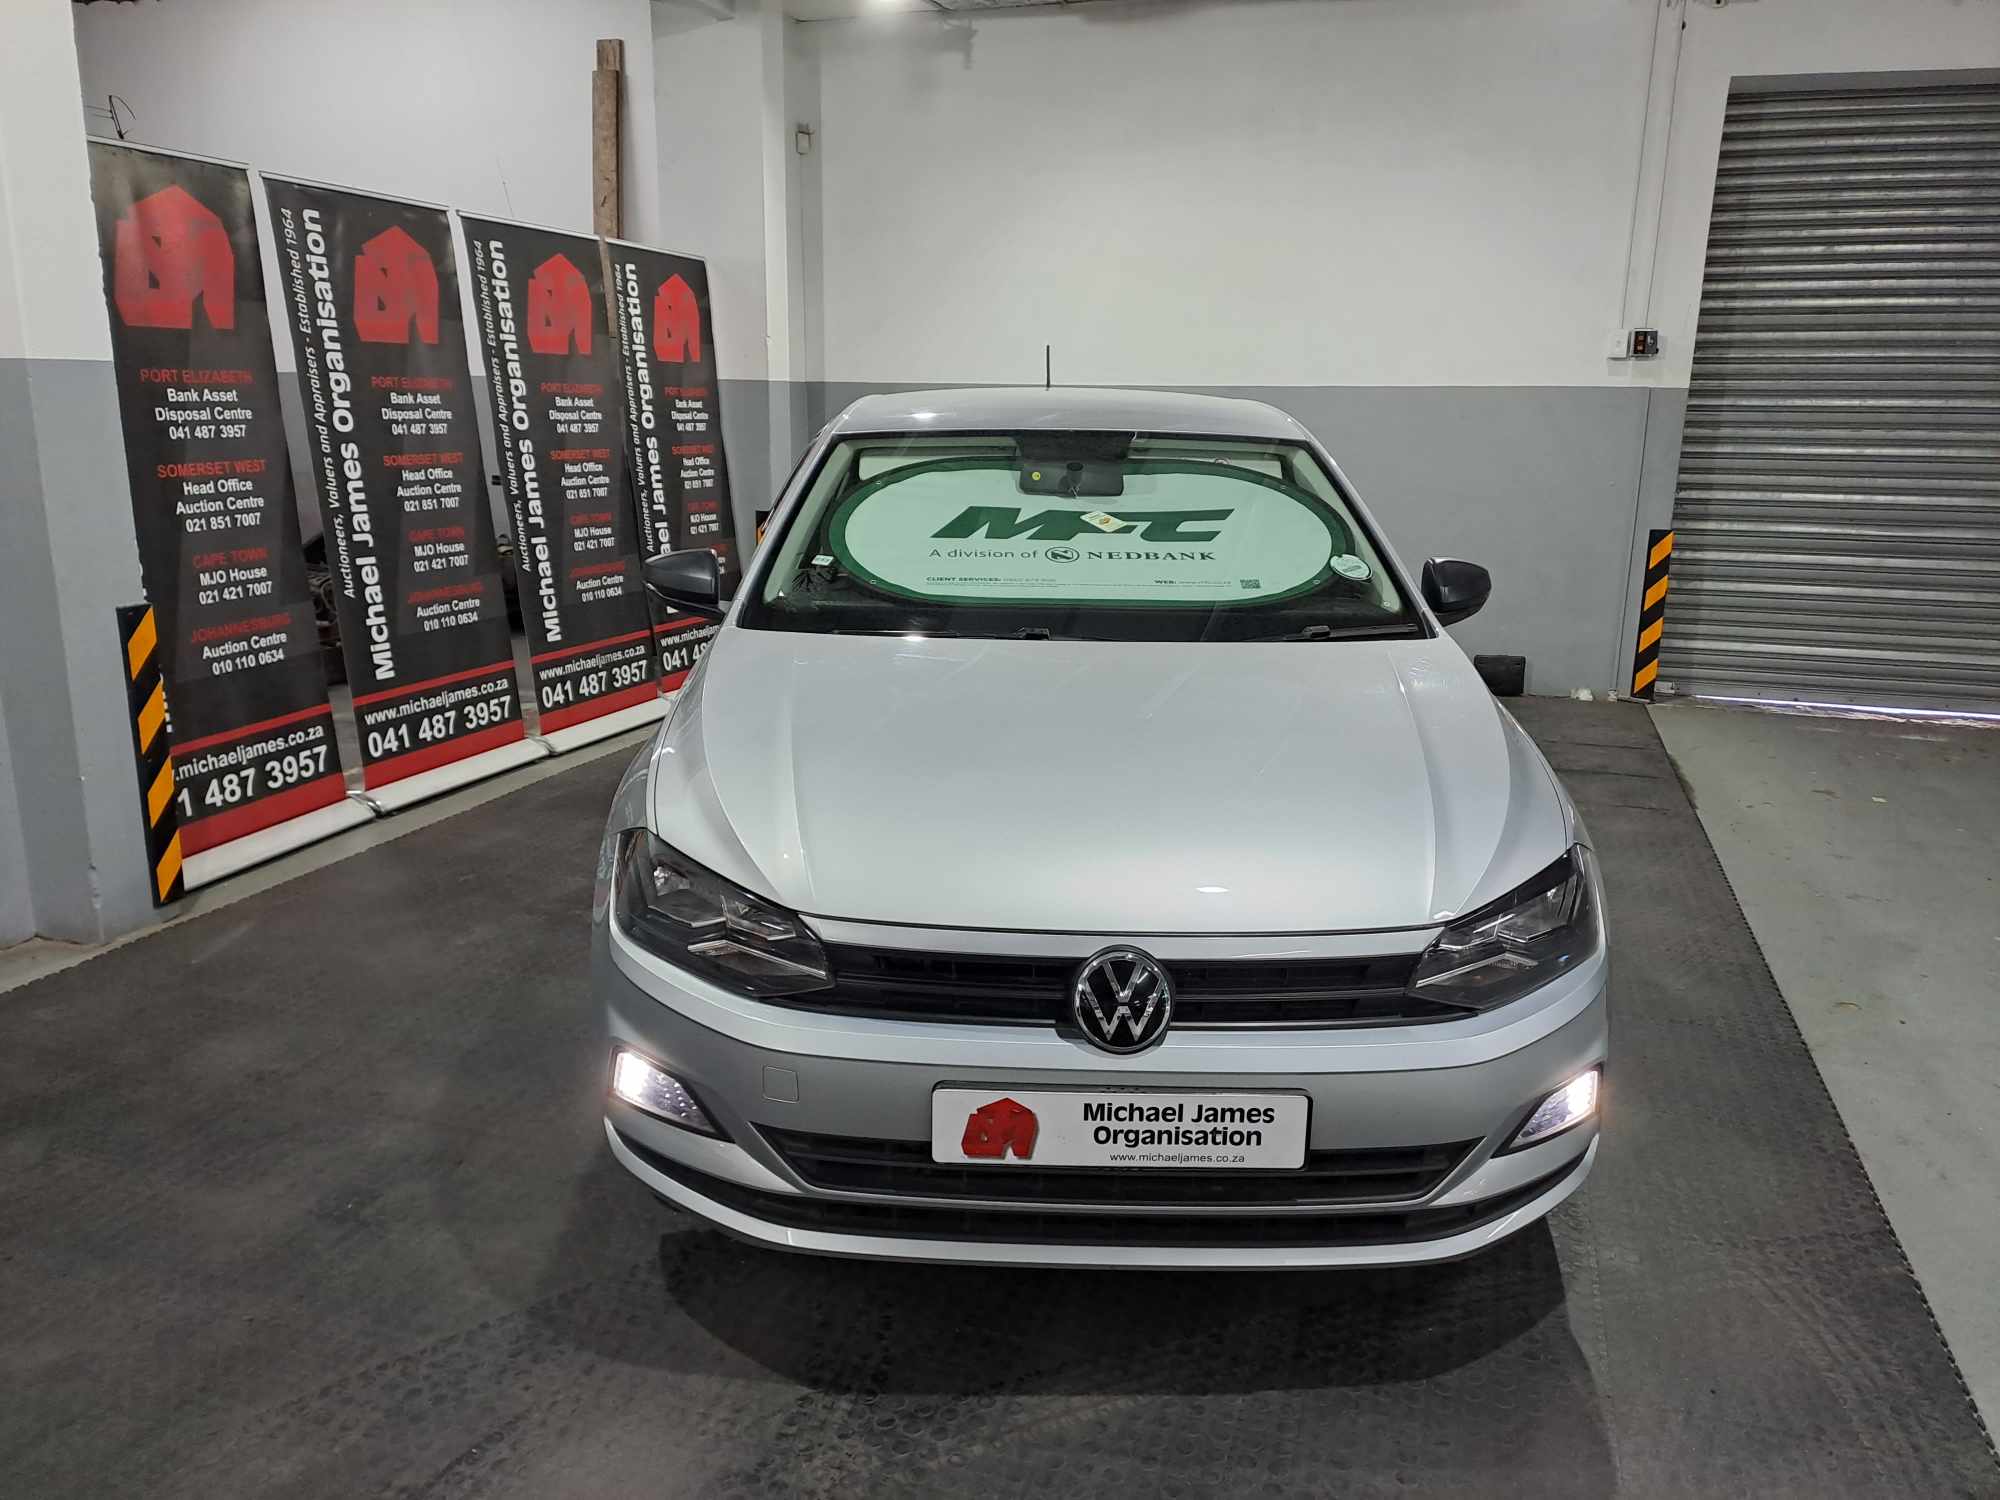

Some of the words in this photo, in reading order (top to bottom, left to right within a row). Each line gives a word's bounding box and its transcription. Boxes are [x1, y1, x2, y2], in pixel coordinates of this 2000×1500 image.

[280, 207, 298, 245] 1964
[473, 240, 486, 272] 1964
[286, 249, 312, 334] Established
[303, 208, 354, 433] Organisation
[477, 274, 496, 346] Established
[489, 240, 529, 431] Organisation
[625, 263, 655, 430] Organisation
[140, 369, 177, 382] PORT
[305, 347, 328, 422] Appraisers
[167, 388, 200, 402] Bank
[203, 389, 238, 401] Asset
[390, 392, 415, 404] Bank
[416, 393, 441, 404] Asset
[491, 357, 508, 422] Appraisers
[155, 407, 211, 423] Disposal
[214, 407, 252, 420] Centre
[381, 408, 423, 422] Disposal
[424, 408, 453, 420] Centre
[549, 410, 579, 422] Disposal
[169, 426, 190, 439] 041
[194, 425, 216, 438] 487
[220, 425, 246, 438] 3957
[315, 424, 331, 453] and
[391, 424, 408, 435] 041
[410, 424, 427, 434] 487
[500, 424, 512, 448] and
[630, 423, 640, 445] and
[157, 462, 230, 477] SOMERSET
[234, 459, 266, 473] WEST
[402, 469, 425, 481] Head
[427, 468, 453, 480] Office
[505, 450, 519, 495] Valuers
[564, 463, 581, 473] Head
[582, 462, 603, 472] Office
[635, 447, 646, 486] Valuers
[646, 436, 667, 515] James
[183, 481, 214, 495] Head
[217, 479, 253, 492] Office
[323, 457, 340, 508] Valuers
[397, 486, 432, 497] Auction
[434, 483, 462, 494] Centre
[519, 439, 544, 529] James
[561, 477, 587, 486] Auction
[176, 501, 224, 515] Auction
[227, 496, 264, 509] Centre
[340, 442, 374, 548] James
[404, 501, 420, 512] 021
[422, 499, 438, 510] 851
[440, 497, 460, 508] 7007
[185, 519, 207, 532] 021
[210, 516, 231, 530] 851
[235, 512, 262, 526] 7007
[590, 527, 612, 536] House
[513, 500, 531, 572] Auctioneers,
[333, 514, 356, 598] Auctioneers,
[414, 544, 434, 557] MJO
[436, 542, 464, 553] House
[928, 549, 941, 558] A
[948, 549, 1014, 558] division
[1020, 549, 1038, 558] of
[1088, 552, 1216, 561] NEDBANK
[200, 570, 227, 586] MJO
[229, 566, 267, 582] House
[413, 560, 429, 573] 021
[432, 558, 446, 569] 421
[449, 555, 469, 567] 7007
[199, 589, 219, 605] 021
[222, 586, 243, 601] 421
[246, 581, 273, 596] 7007
[531, 536, 562, 643] Michael
[576, 579, 601, 590] Auction
[355, 556, 396, 681] Michael
[416, 603, 450, 617] Auction
[451, 598, 480, 611] Centre
[423, 619, 439, 632] 010
[441, 615, 456, 627] 110
[458, 611, 478, 624] 0634
[202, 640, 248, 660] Auction
[250, 632, 287, 650] Centre
[212, 659, 233, 676] 010
[235, 654, 256, 670] 110
[258, 648, 285, 665] 0634
[539, 645, 645, 680] www.michaeljames.co.za
[663, 647, 688, 671] 041
[542, 680, 573, 708] 041
[579, 671, 607, 696] 487
[612, 659, 647, 687] 3957
[364, 678, 509, 726] www.michaeljames.co.za
[367, 724, 411, 758] 041
[419, 710, 456, 742] 487
[463, 695, 511, 729] 3957
[173, 725, 324, 781] .michaeljames.co.za
[204, 767, 256, 807] 487
[265, 744, 328, 789] 3957
[1083, 1103, 1184, 1123] Michael
[1191, 1104, 1275, 1124] James
[1093, 1126, 1262, 1148] Organisation
[1109, 1153, 1245, 1164] www.michaeljames.co.za
